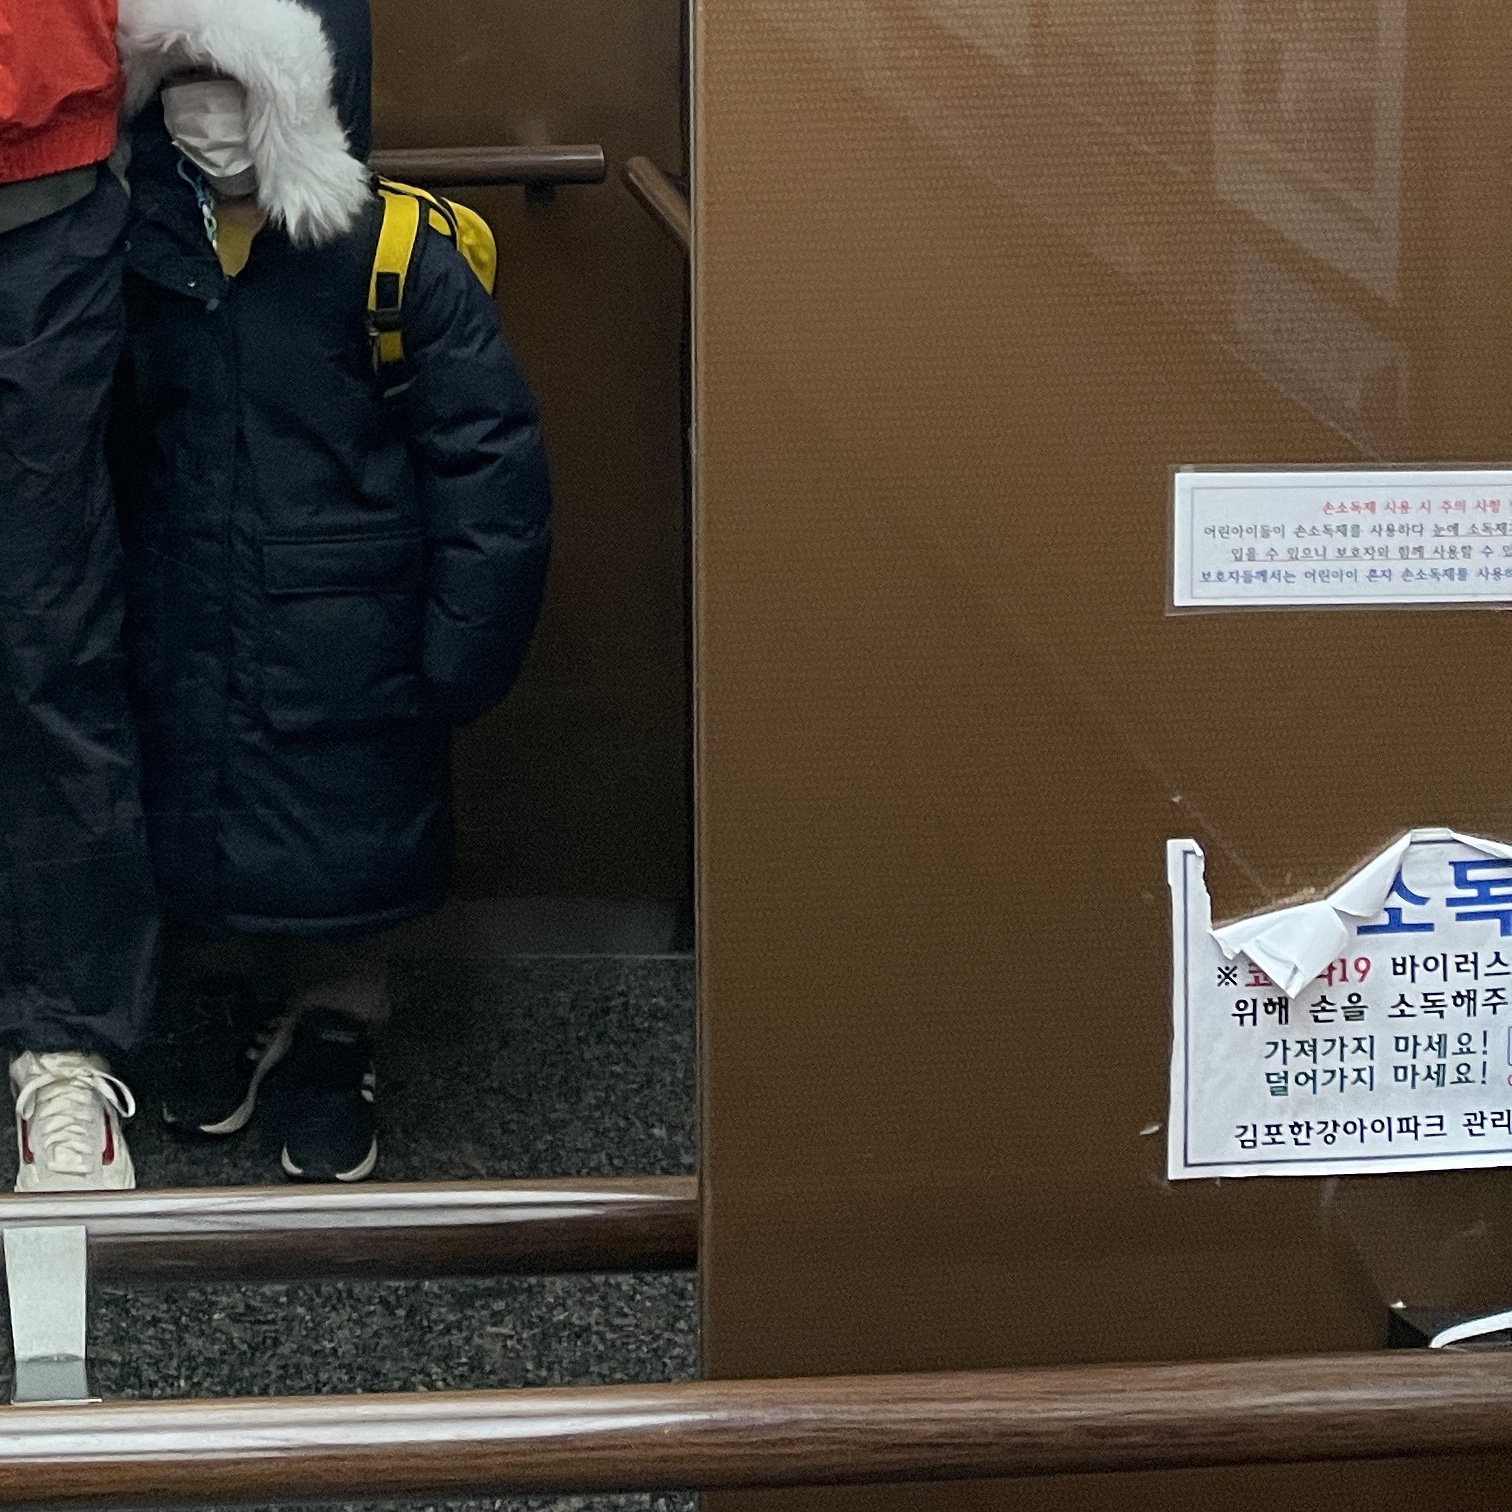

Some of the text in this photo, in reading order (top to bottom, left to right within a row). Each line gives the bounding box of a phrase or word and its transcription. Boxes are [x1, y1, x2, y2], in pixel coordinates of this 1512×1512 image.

[1384, 500, 1410, 514] 사용
[1441, 500, 1466, 514] 주의
[1265, 548, 1278, 561] 수
[1288, 547, 1327, 560] 있으니
[1481, 545, 1494, 558] 수
[1304, 569, 1358, 582] 어린아이
[1392, 951, 1512, 983] 바이러스
[1231, 988, 1509, 1027] 위해 손을 소독해주
[1264, 1030, 1488, 1065] 가져가지 마세요!
[1265, 1061, 1487, 1097] 덜어가지 마세요!
[1235, 1114, 1448, 1149] 김포한강아이파크
